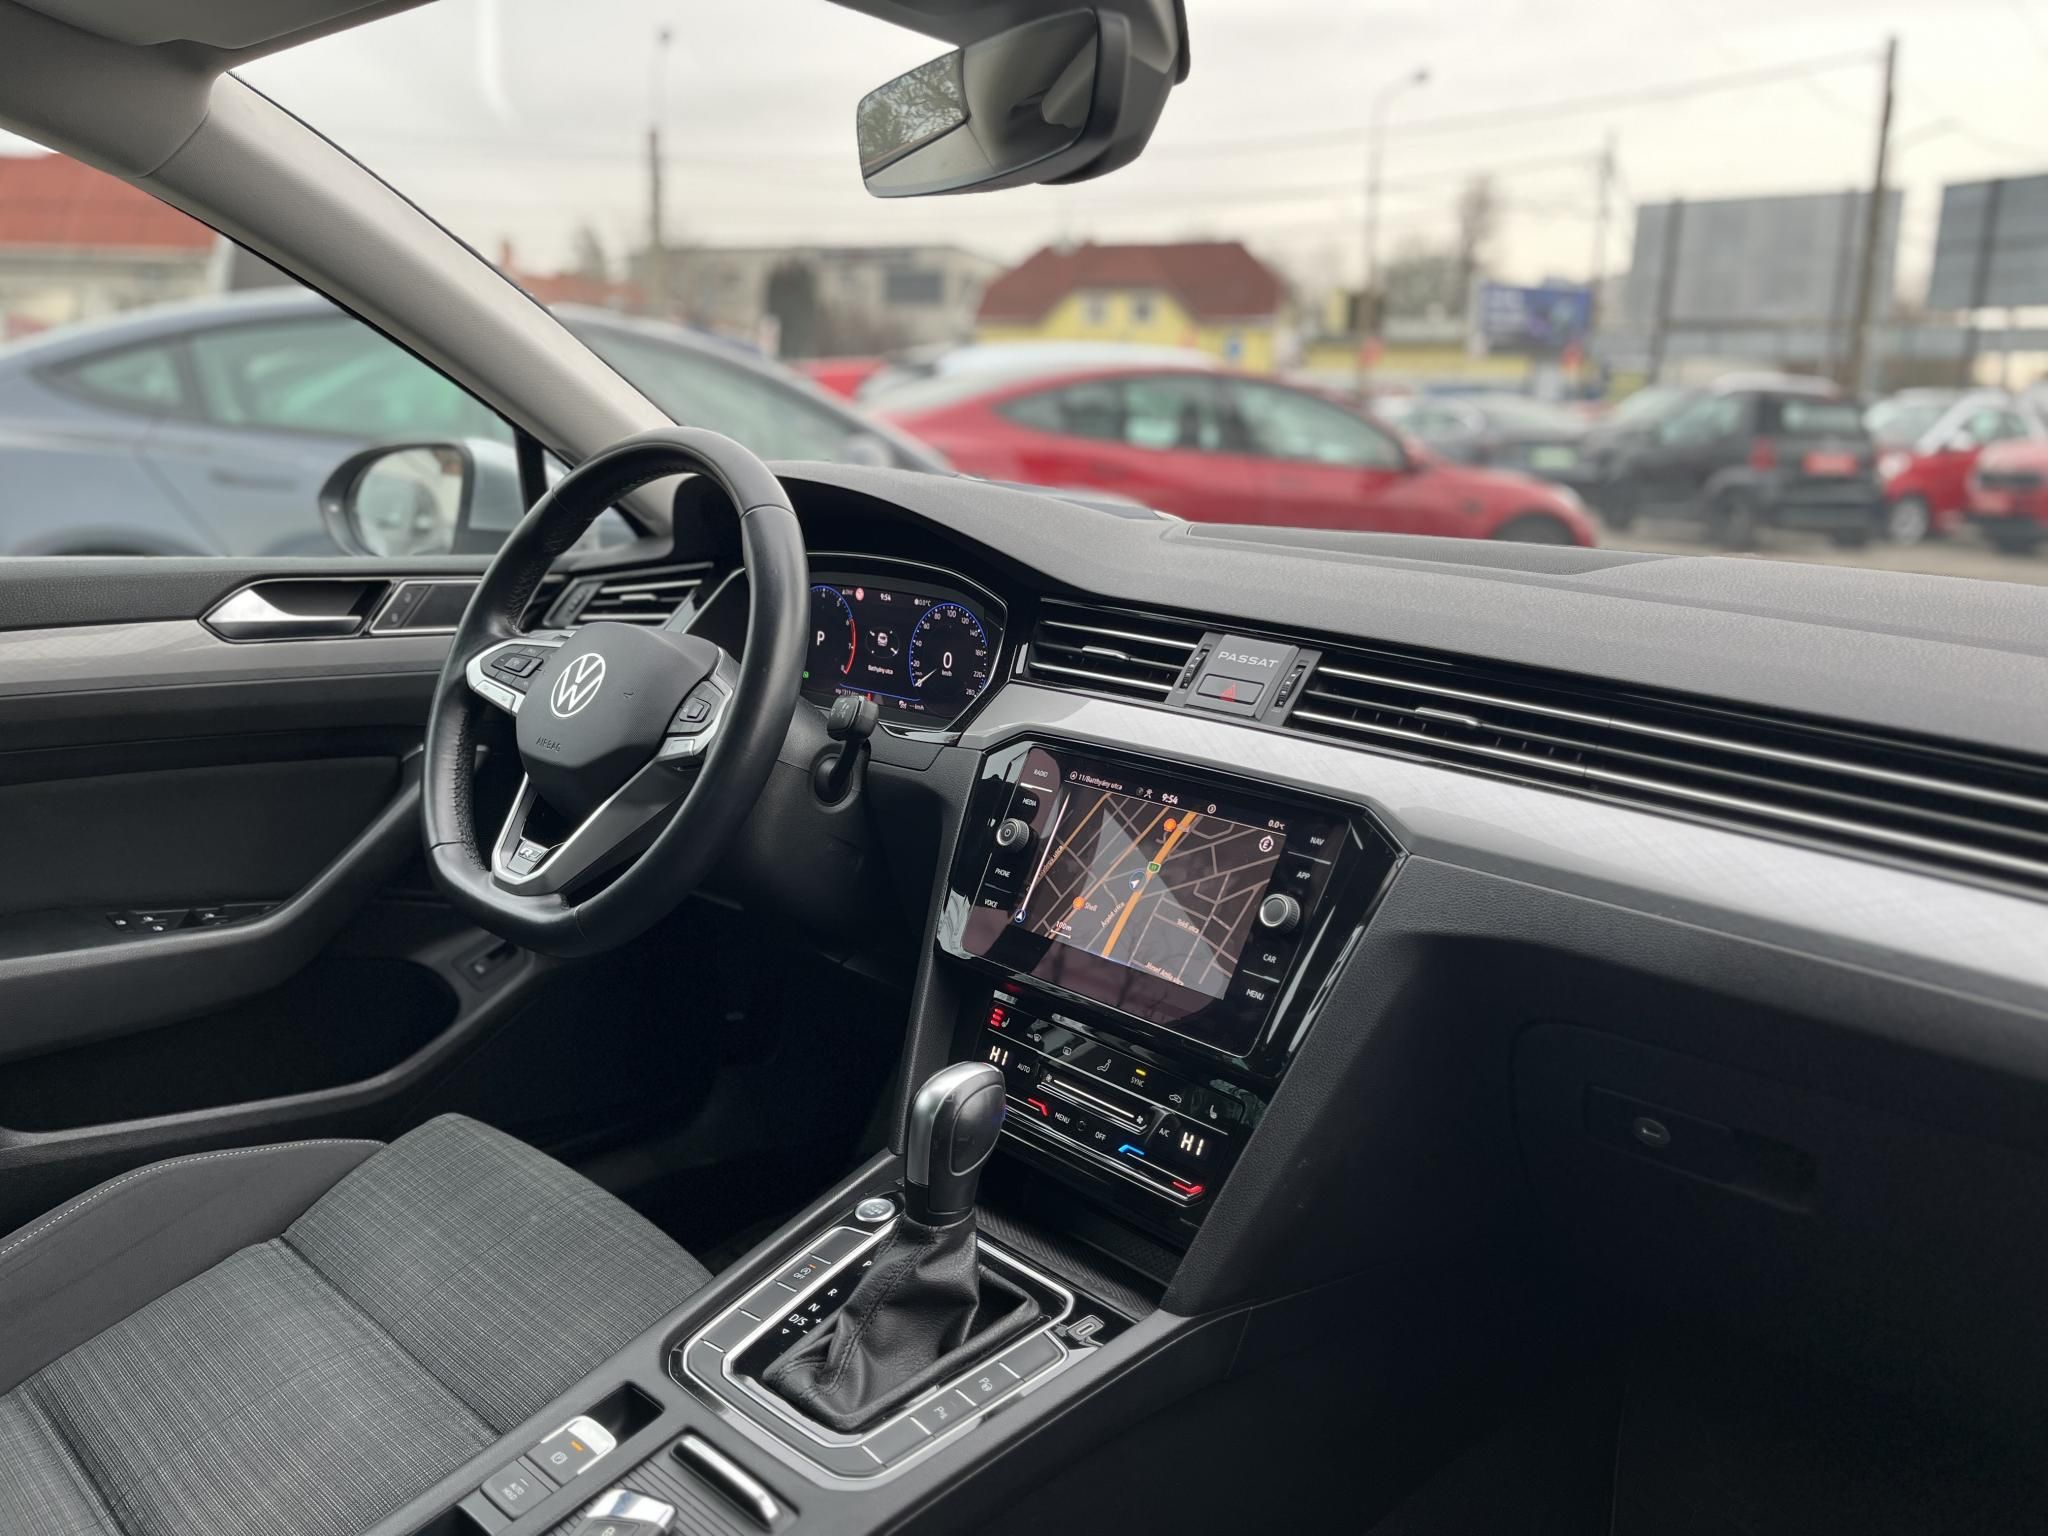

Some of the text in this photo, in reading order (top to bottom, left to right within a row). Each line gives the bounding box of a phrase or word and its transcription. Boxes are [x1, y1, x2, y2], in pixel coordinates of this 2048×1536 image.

[947, 610, 957, 618] 100
[961, 617, 970, 625] 120
[816, 630, 826, 646] P
[969, 629, 979, 638] 140
[975, 648, 985, 657] 180
[913, 660, 921, 668] 20
[943, 651, 953, 669] 0
[1218, 651, 1279, 668] PASSAT
[973, 671, 984, 679] 220
[1033, 768, 1049, 778] RADIO
[1022, 797, 1037, 807] MEDIA
[1161, 793, 1179, 805] 9:54
[1309, 836, 1325, 847] NAV
[994, 867, 1011, 878] PHONE
[1296, 871, 1311, 881] APP
[984, 898, 999, 909] VOICE
[1262, 953, 1277, 964] CAR
[1246, 988, 1265, 1001] MENU
[989, 1045, 1008, 1066] HI
[1017, 1063, 1031, 1074] AUTO
[1130, 1076, 1145, 1088] SYNC
[1055, 1111, 1070, 1125] MENU
[1095, 1131, 1106, 1141] OFF
[1158, 1127, 1170, 1138] A/C
[1180, 1132, 1205, 1156] HI
[862, 1260, 872, 1268] P
[827, 1288, 838, 1297] R
[808, 1303, 820, 1313] N
[789, 1313, 808, 1327] D/S
